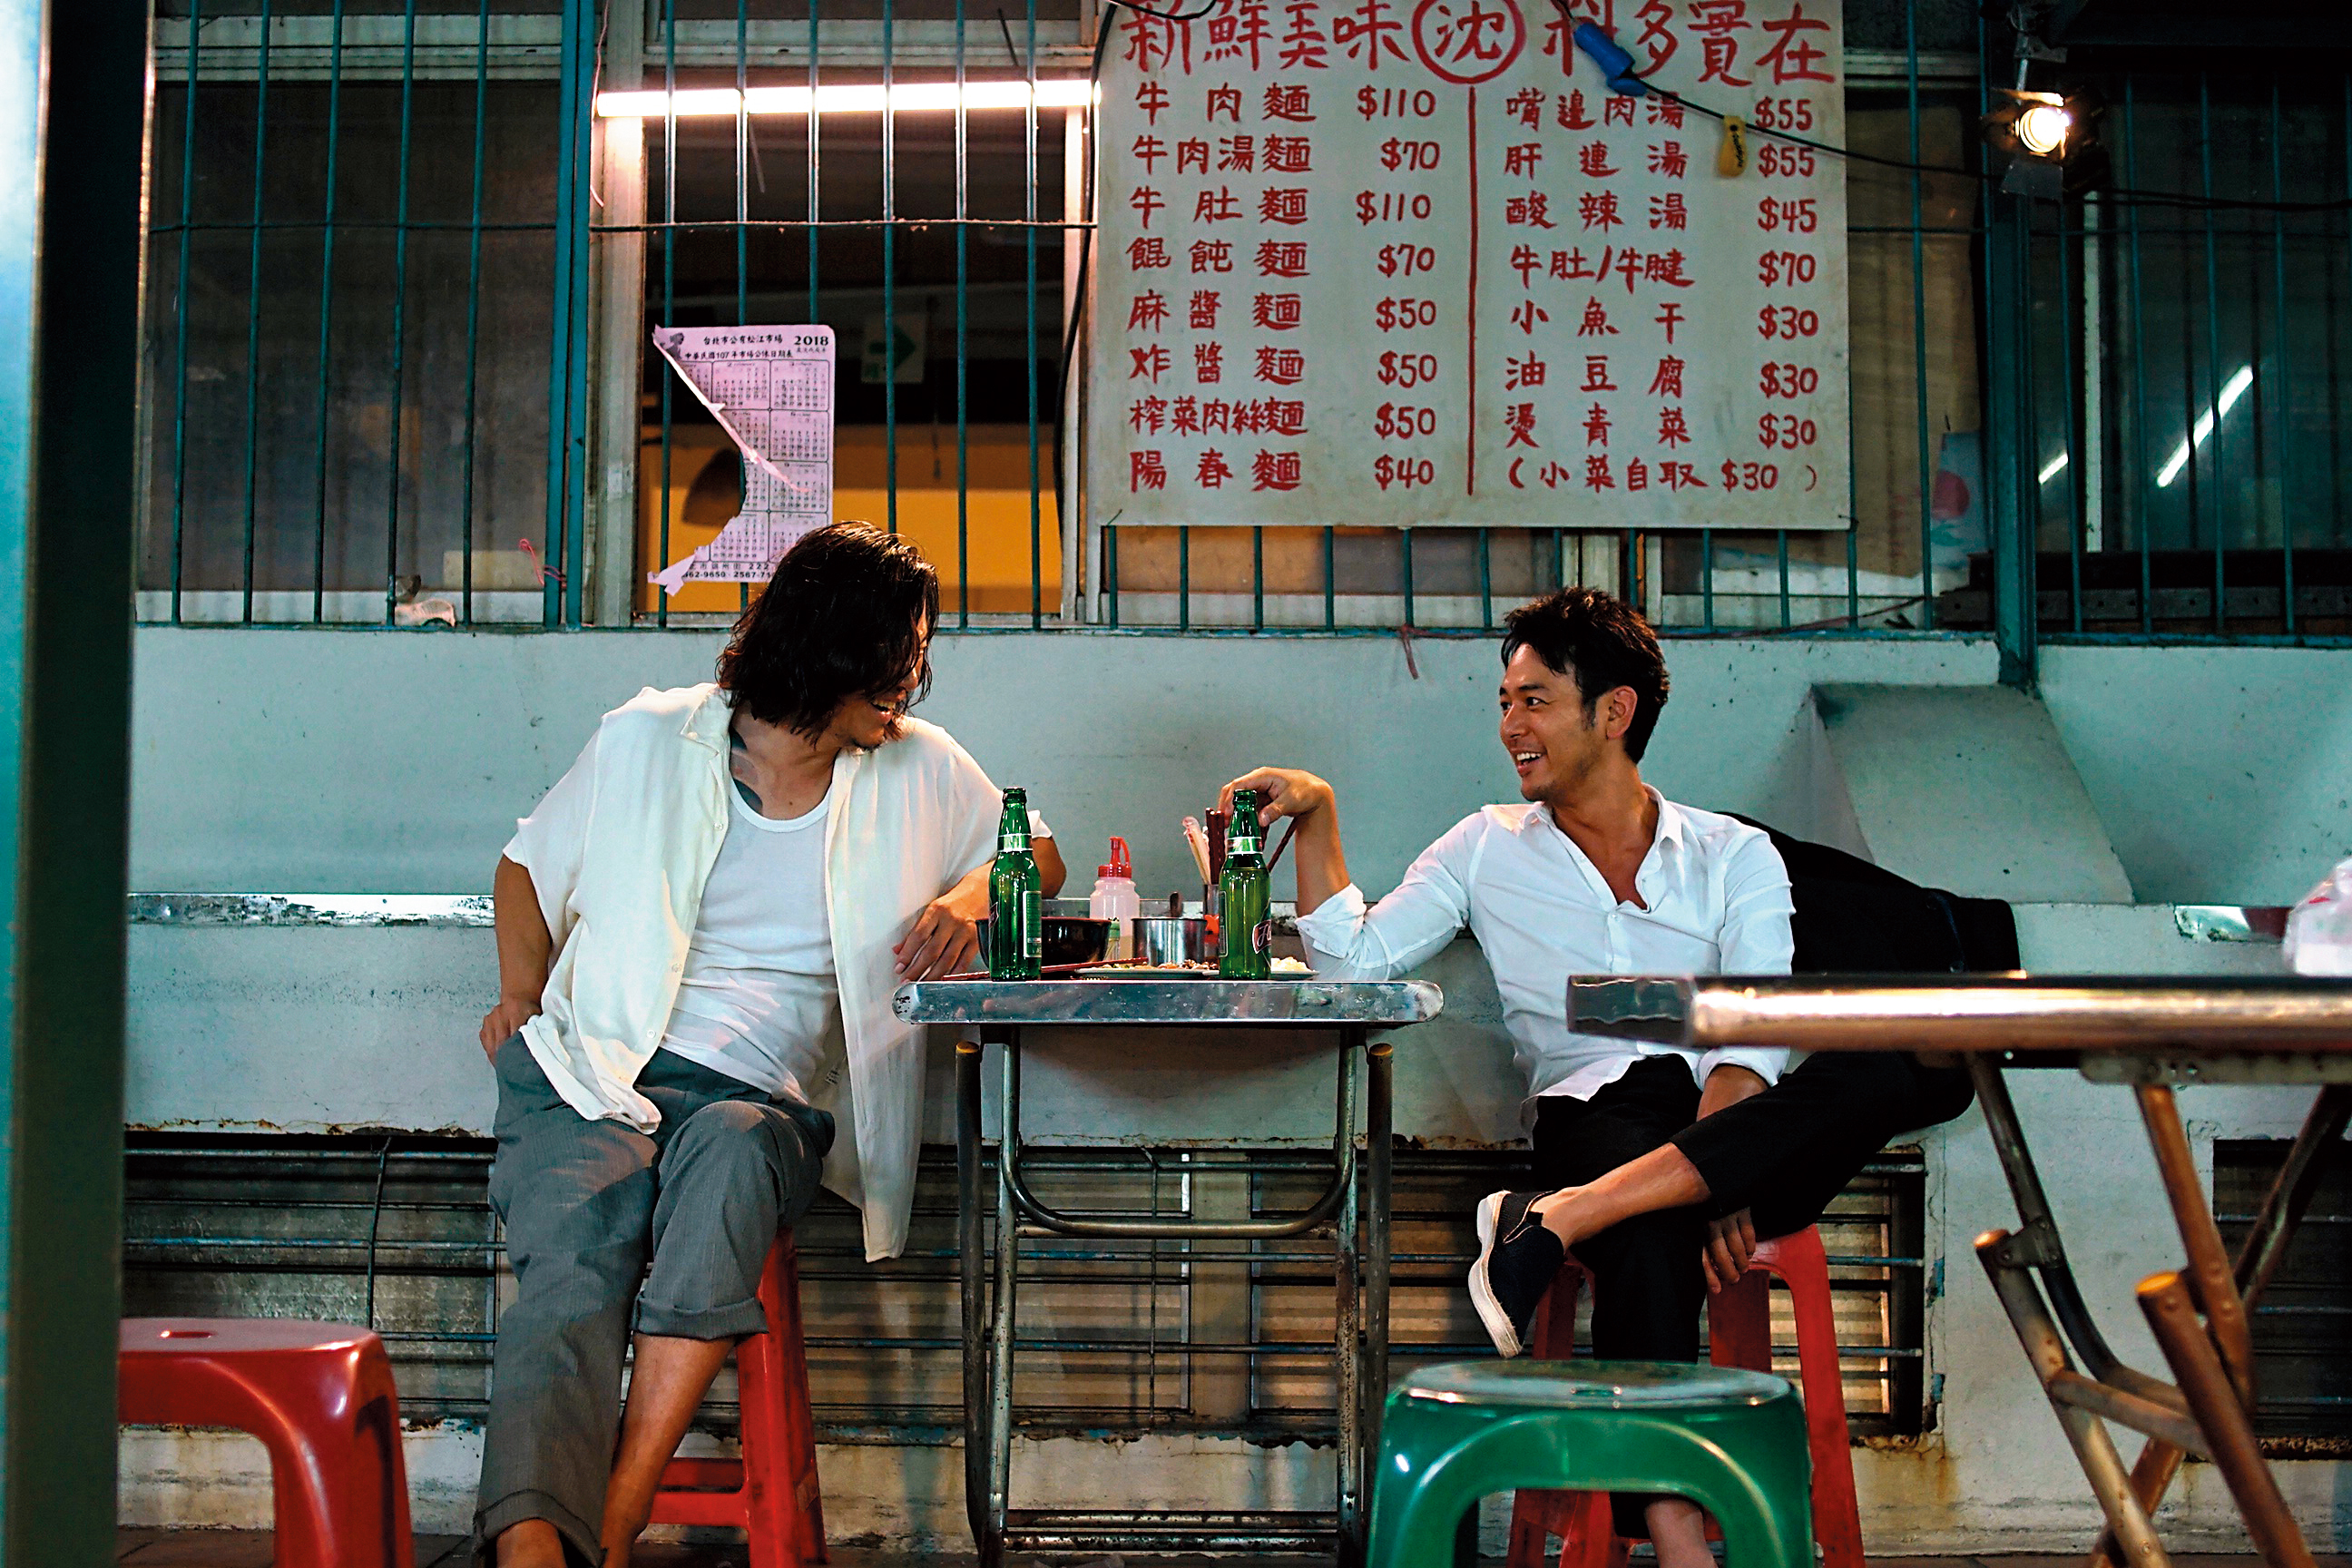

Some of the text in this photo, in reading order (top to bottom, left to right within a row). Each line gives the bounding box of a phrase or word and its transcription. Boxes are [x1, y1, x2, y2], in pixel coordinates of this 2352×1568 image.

[1121, 0, 1411, 74] 新鮮美味
[1434, 3, 1506, 64] 沈
[1136, 81, 1436, 125] 牛肉麵 $110
[1505, 88, 1814, 132] 嘴邊肉湯 $55
[1132, 133, 1441, 175] 牛肉湯麵 $70
[1504, 140, 1690, 181] 肝連湯
[1758, 142, 1816, 178] $55
[1130, 185, 1433, 230] 牛肚麵 $110
[1505, 189, 1818, 233] 酸辣湯 $45
[1126, 236, 1436, 278] 餛飩麵 $70
[1758, 250, 1817, 288] $70
[1126, 289, 1437, 333] 麻醬麵 $50
[1510, 295, 1820, 345] 小魚干 $30
[793, 335, 829, 347] 2018
[1129, 340, 1438, 388] 炸醬麵 $50
[1504, 349, 1820, 399] 油豆腐 $30
[1129, 395, 1437, 440] 榨菜肉絲麵 $50
[1504, 402, 1818, 450] 燙青菜 $30
[1130, 447, 1436, 494] 陽春麵 $40
